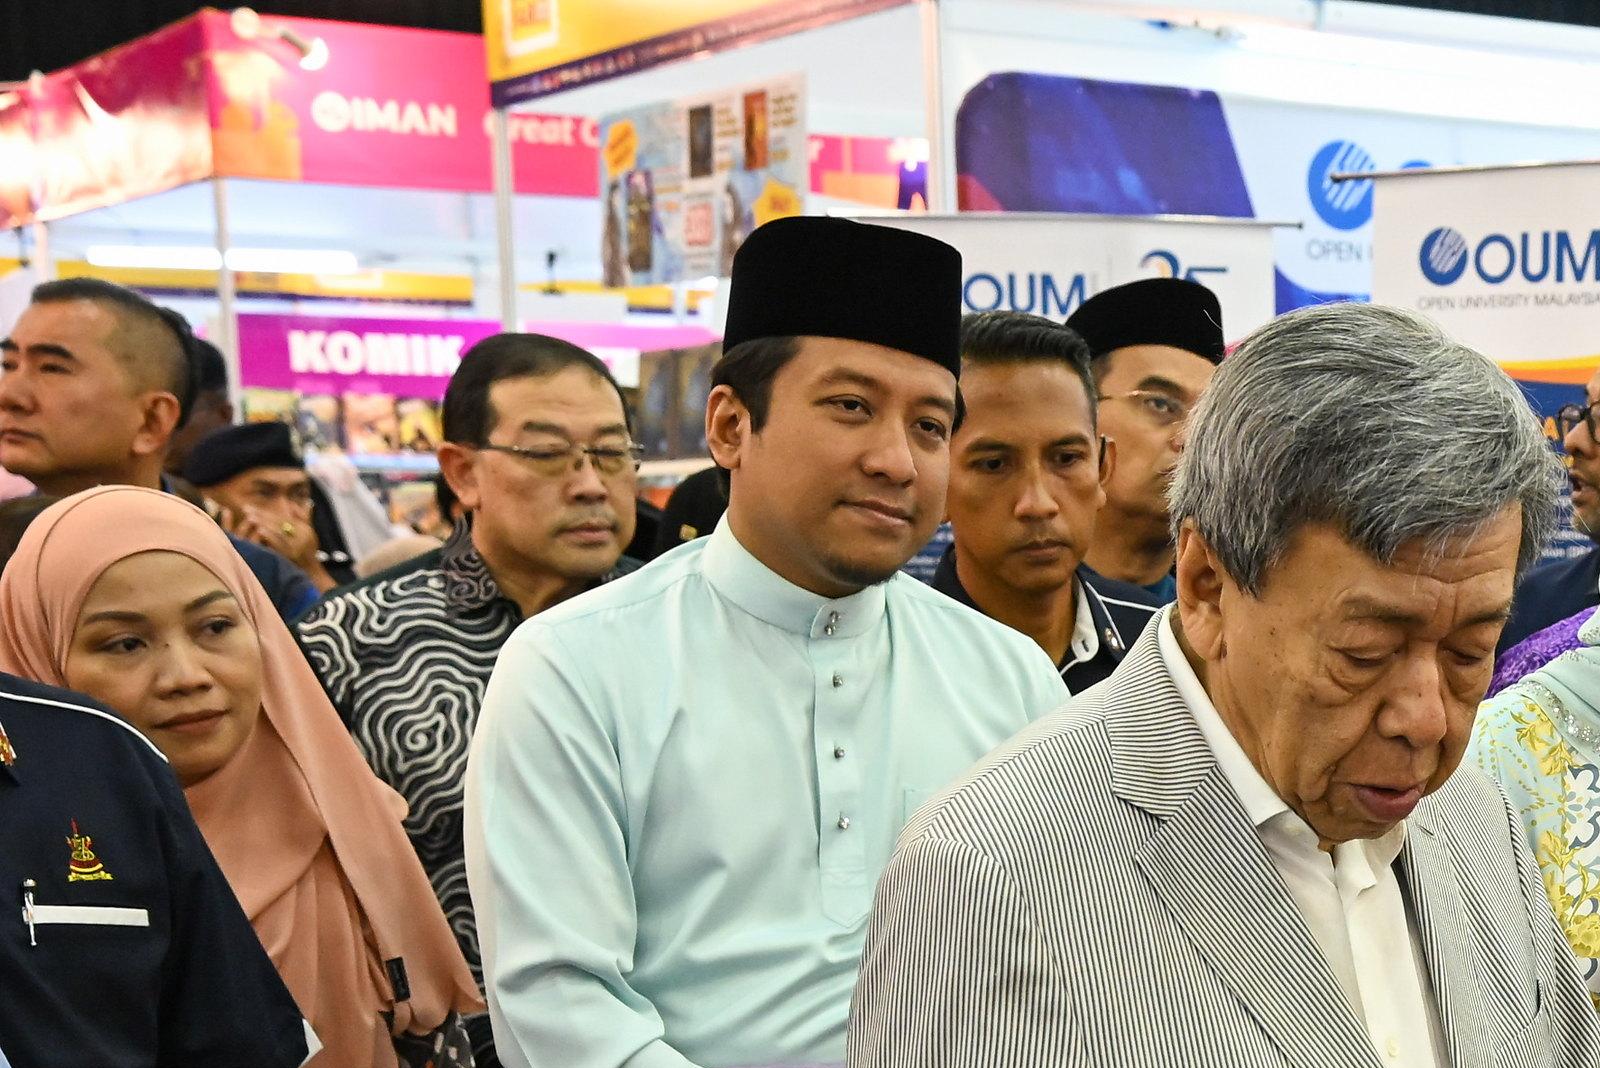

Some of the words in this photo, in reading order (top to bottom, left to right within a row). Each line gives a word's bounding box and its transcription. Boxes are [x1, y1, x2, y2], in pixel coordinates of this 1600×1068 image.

[351, 97, 457, 137] IMAN
[963, 273, 1087, 316] OUM
[1419, 296, 1455, 310] OPEN
[1459, 294, 1530, 309] UNIVERSITY
[287, 329, 466, 378] KOMIK
